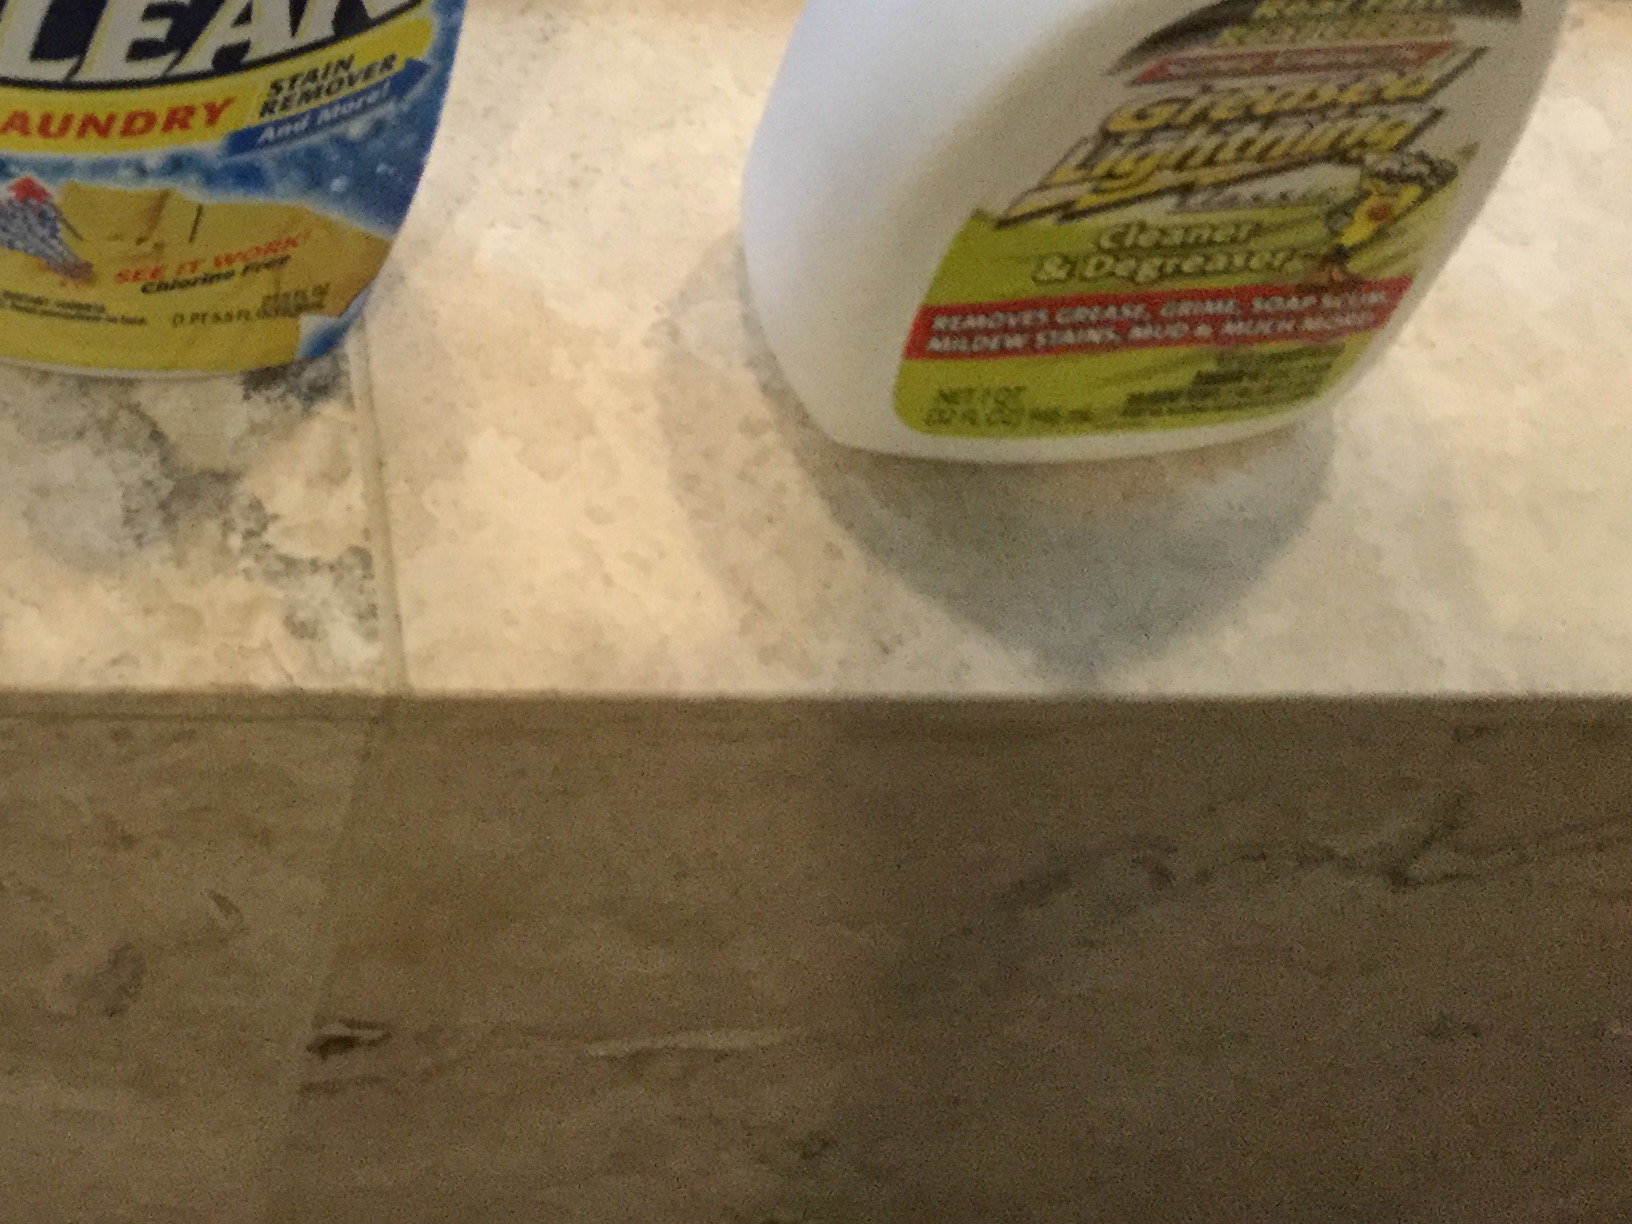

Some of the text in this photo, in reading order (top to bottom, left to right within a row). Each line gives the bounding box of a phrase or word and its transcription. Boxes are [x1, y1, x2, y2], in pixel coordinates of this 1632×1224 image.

[258, 53, 397, 118] REMOVER
[269, 54, 356, 95] STAIN
[1098, 219, 1258, 253] Cleaner
[113, 265, 166, 285] SEE
[175, 257, 206, 276] IT
[1032, 255, 1075, 283] &
[930, 307, 1049, 333] REMOVES
[927, 330, 1028, 354] MILDEW
